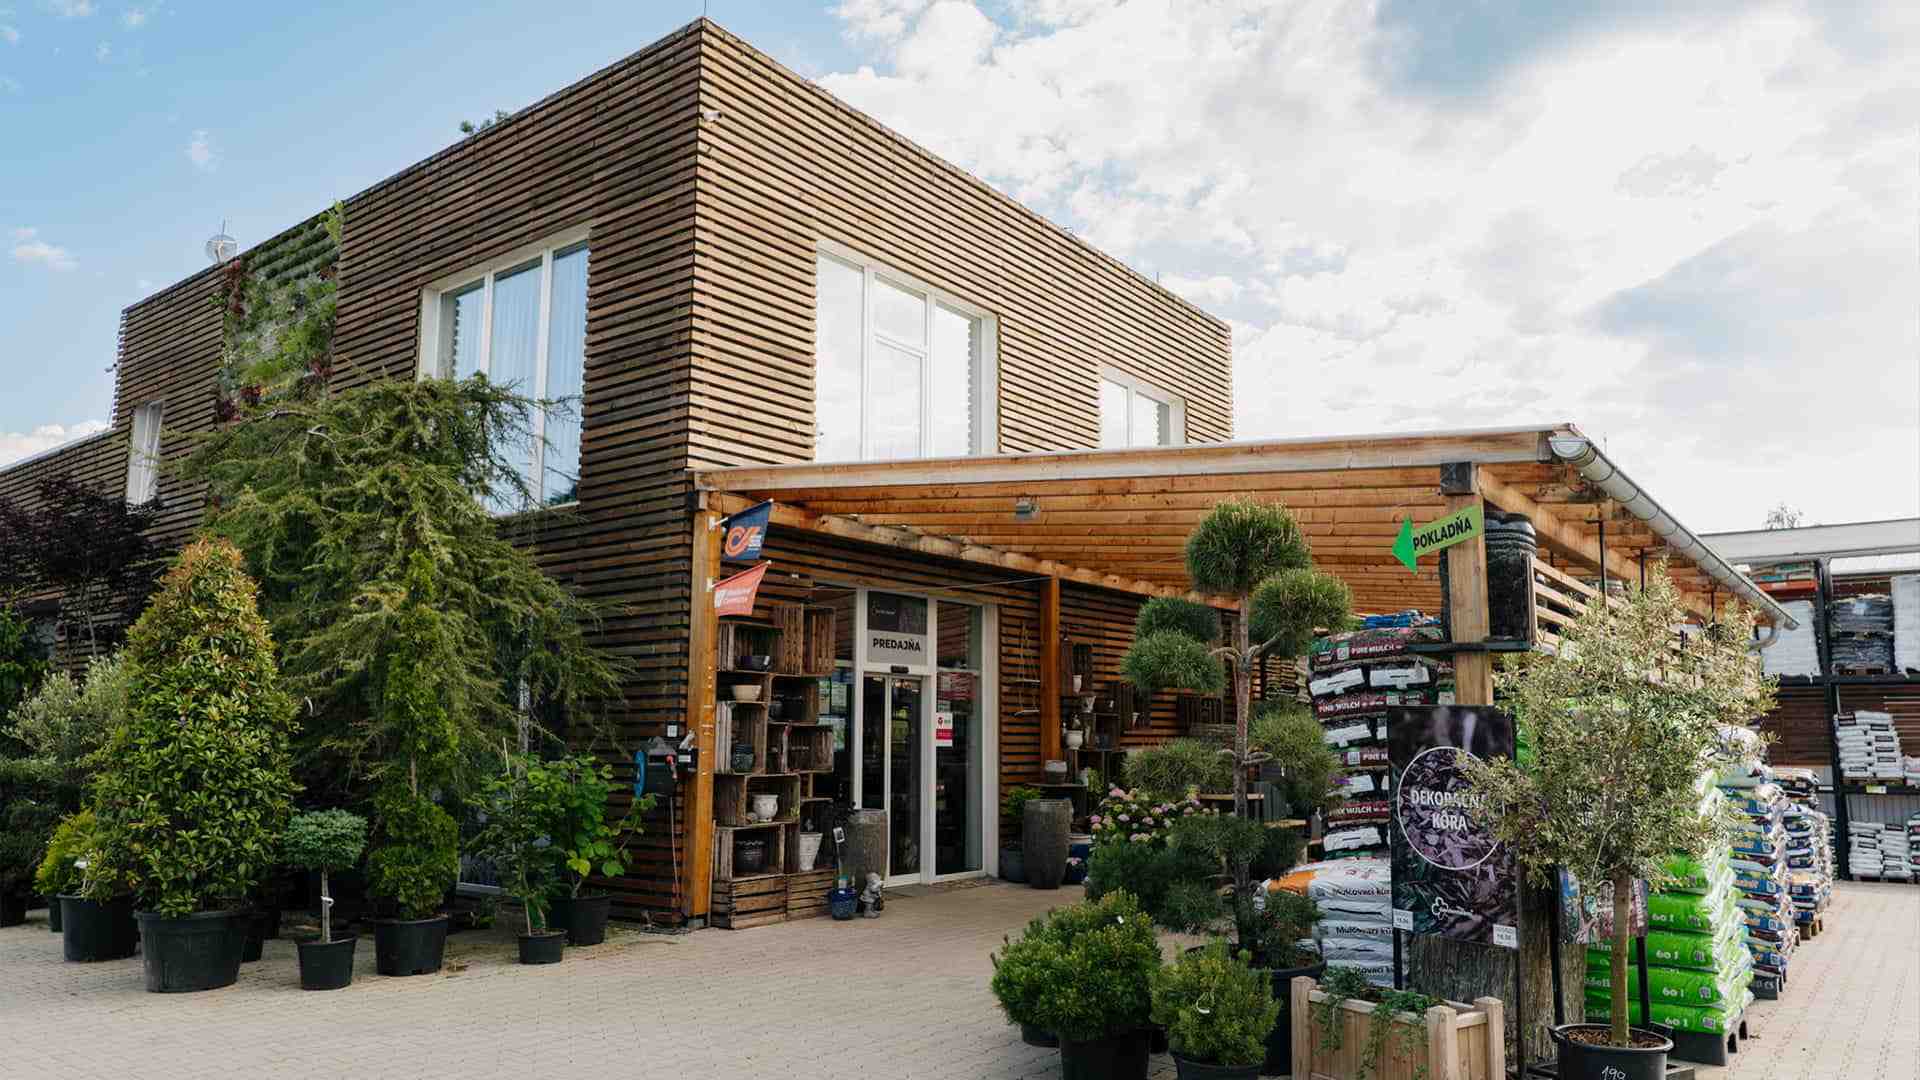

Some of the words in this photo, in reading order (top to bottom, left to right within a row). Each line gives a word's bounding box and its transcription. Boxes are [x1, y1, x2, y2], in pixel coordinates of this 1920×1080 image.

[1413, 515, 1472, 550] POKLADŇA
[872, 637, 921, 652] PREDAJŇA
[1369, 643, 1394, 653] MULCH
